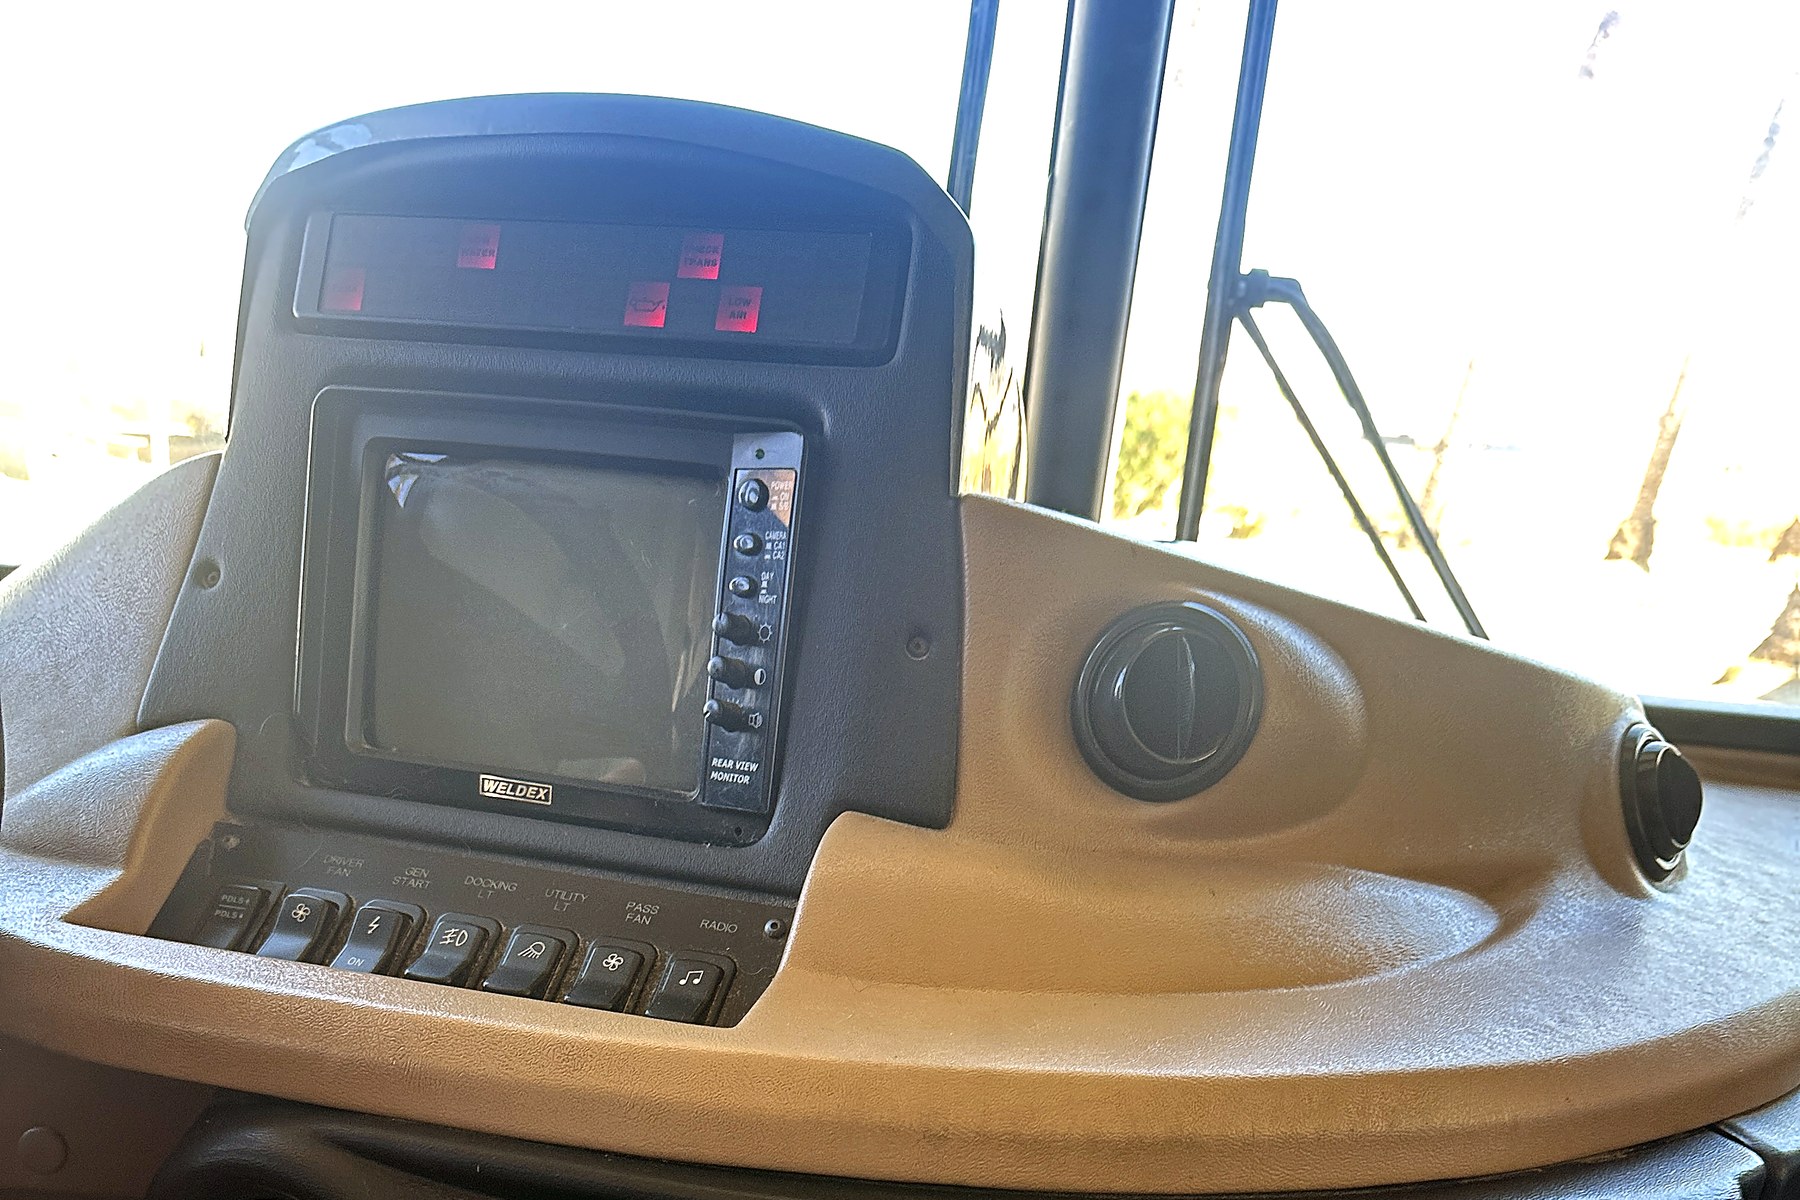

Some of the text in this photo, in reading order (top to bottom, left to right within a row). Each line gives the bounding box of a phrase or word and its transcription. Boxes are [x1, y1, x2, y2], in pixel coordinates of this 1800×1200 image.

[765, 530, 787, 541] CAMERA
[761, 572, 774, 581] DAY
[758, 594, 777, 605] NIGHT
[711, 757, 759, 773] REAR VIEW
[710, 771, 750, 785] MONITOR
[482, 779, 548, 800] WELDEX
[322, 855, 365, 868] DRIVER
[326, 865, 351, 877] FAN
[404, 867, 430, 879] GEN
[391, 876, 432, 889] START
[464, 875, 518, 892] DOCKING
[477, 888, 495, 899] LT
[544, 888, 589, 903] UTILITY
[552, 901, 571, 912] LT
[625, 901, 660, 915] PASS
[624, 912, 652, 925] FAN
[699, 919, 738, 934] RADIO
[347, 957, 365, 967] ON
